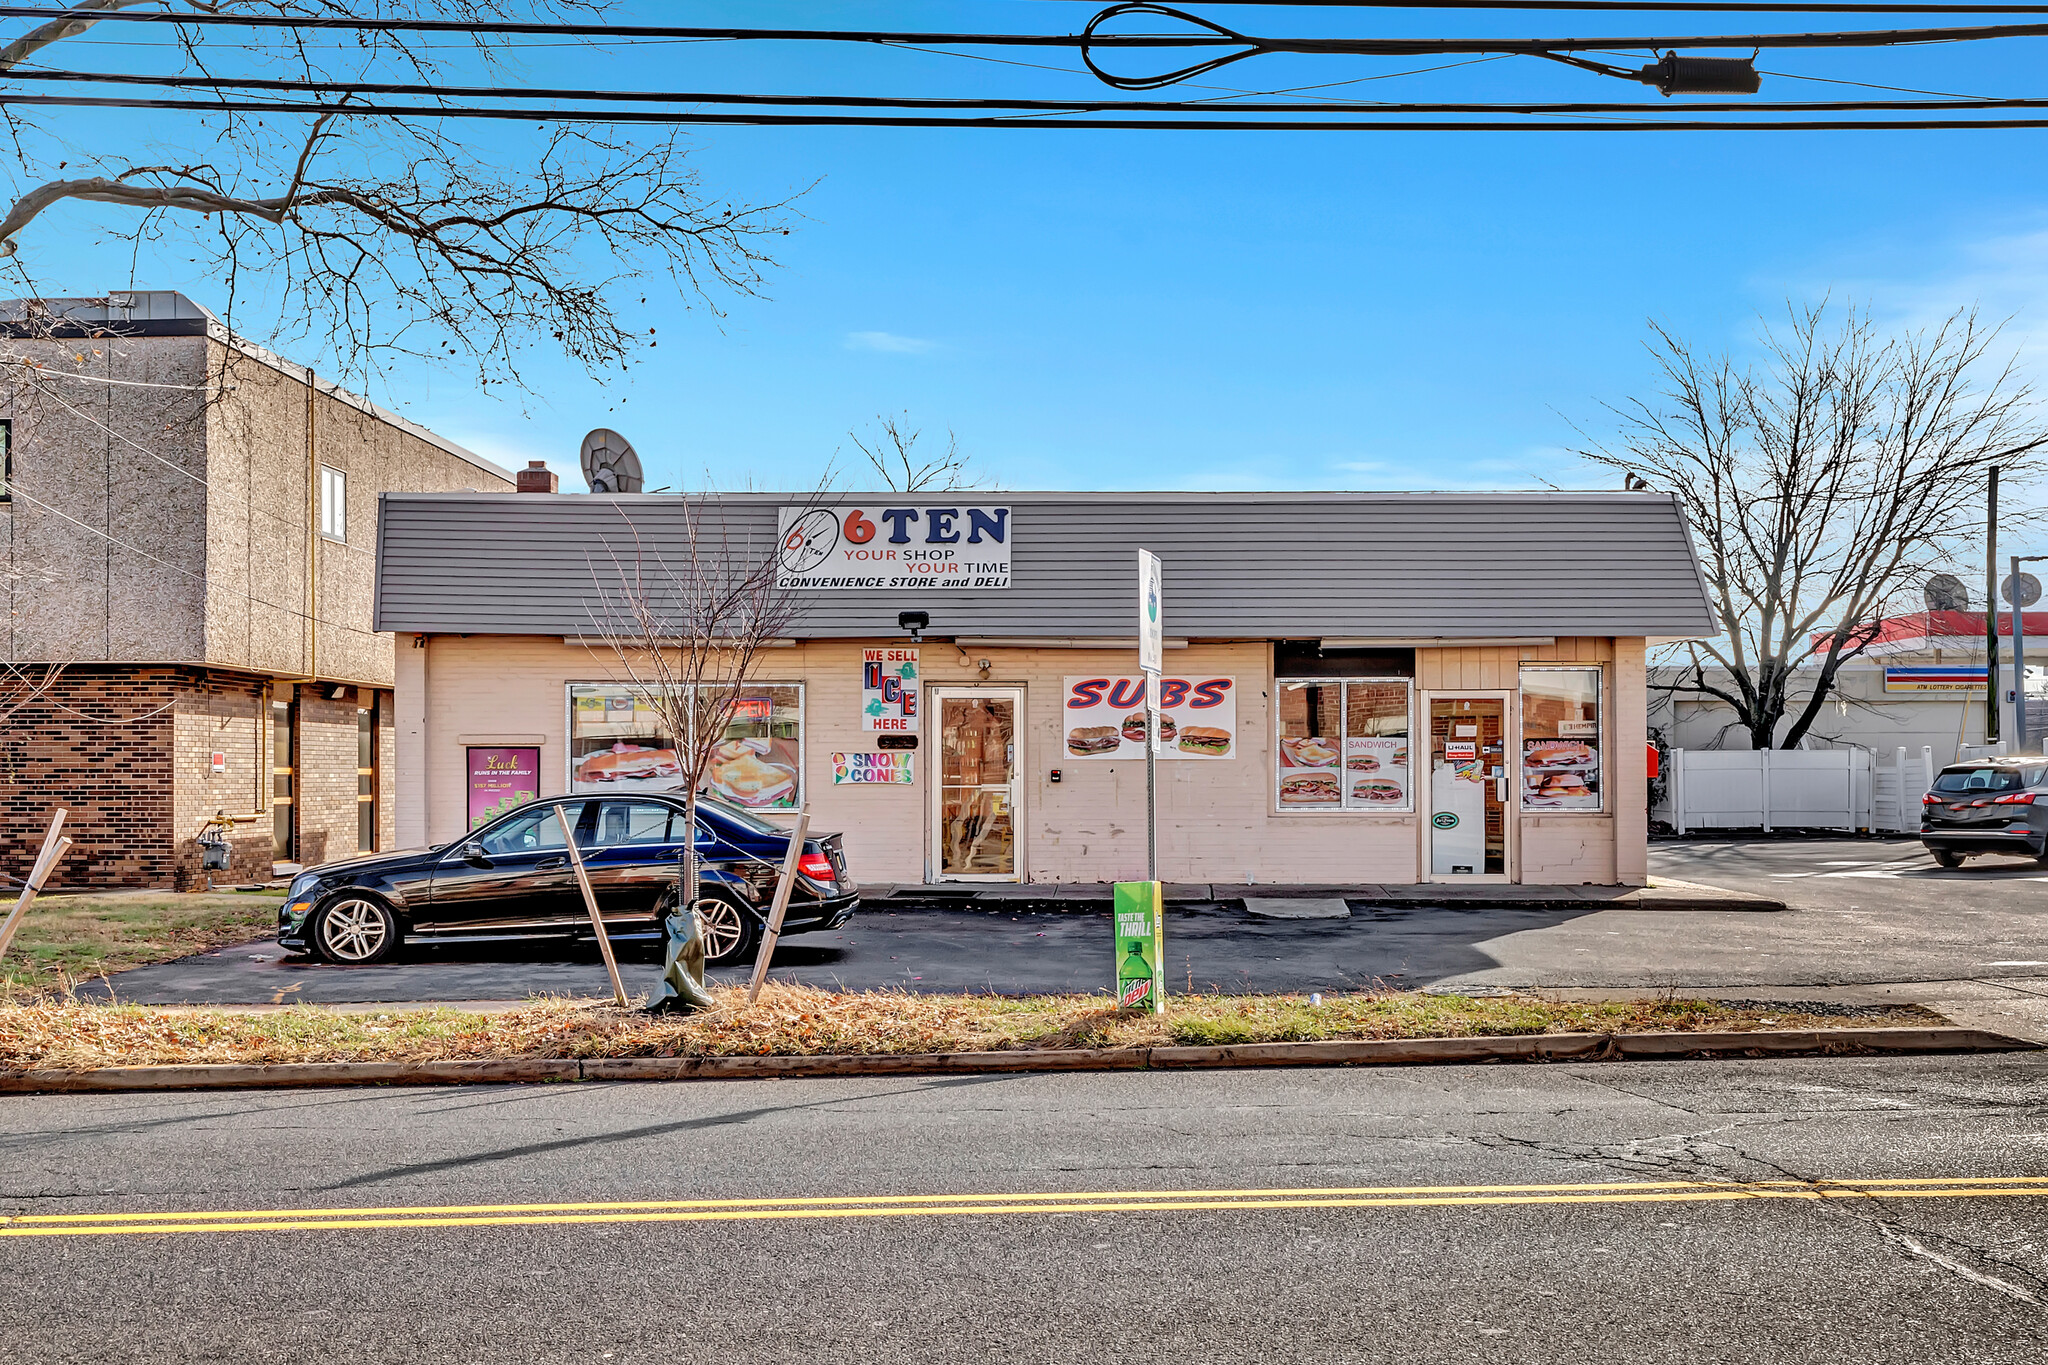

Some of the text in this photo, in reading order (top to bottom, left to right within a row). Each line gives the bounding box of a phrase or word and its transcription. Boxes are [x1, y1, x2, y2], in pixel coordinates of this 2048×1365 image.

[844, 508, 1008, 544] 6TEN
[844, 550, 955, 560] YOUR SHOP
[906, 562, 1008, 573] YOUR TIME
[779, 577, 1008, 587] CONVENIENCE STORE and DELI
[865, 650, 917, 661] WE SELL
[867, 663, 916, 716] ICE
[1067, 679, 1232, 709] SUBS
[873, 719, 907, 729] HERE
[1527, 741, 1585, 750] SANDWICH
[486, 755, 518, 769] Luck
[853, 753, 911, 768] SNOW
[851, 769, 912, 783] CONES
[1118, 913, 1133, 922] TASTE
[1134, 912, 1145, 921] THE
[1120, 922, 1152, 937] THRILL
